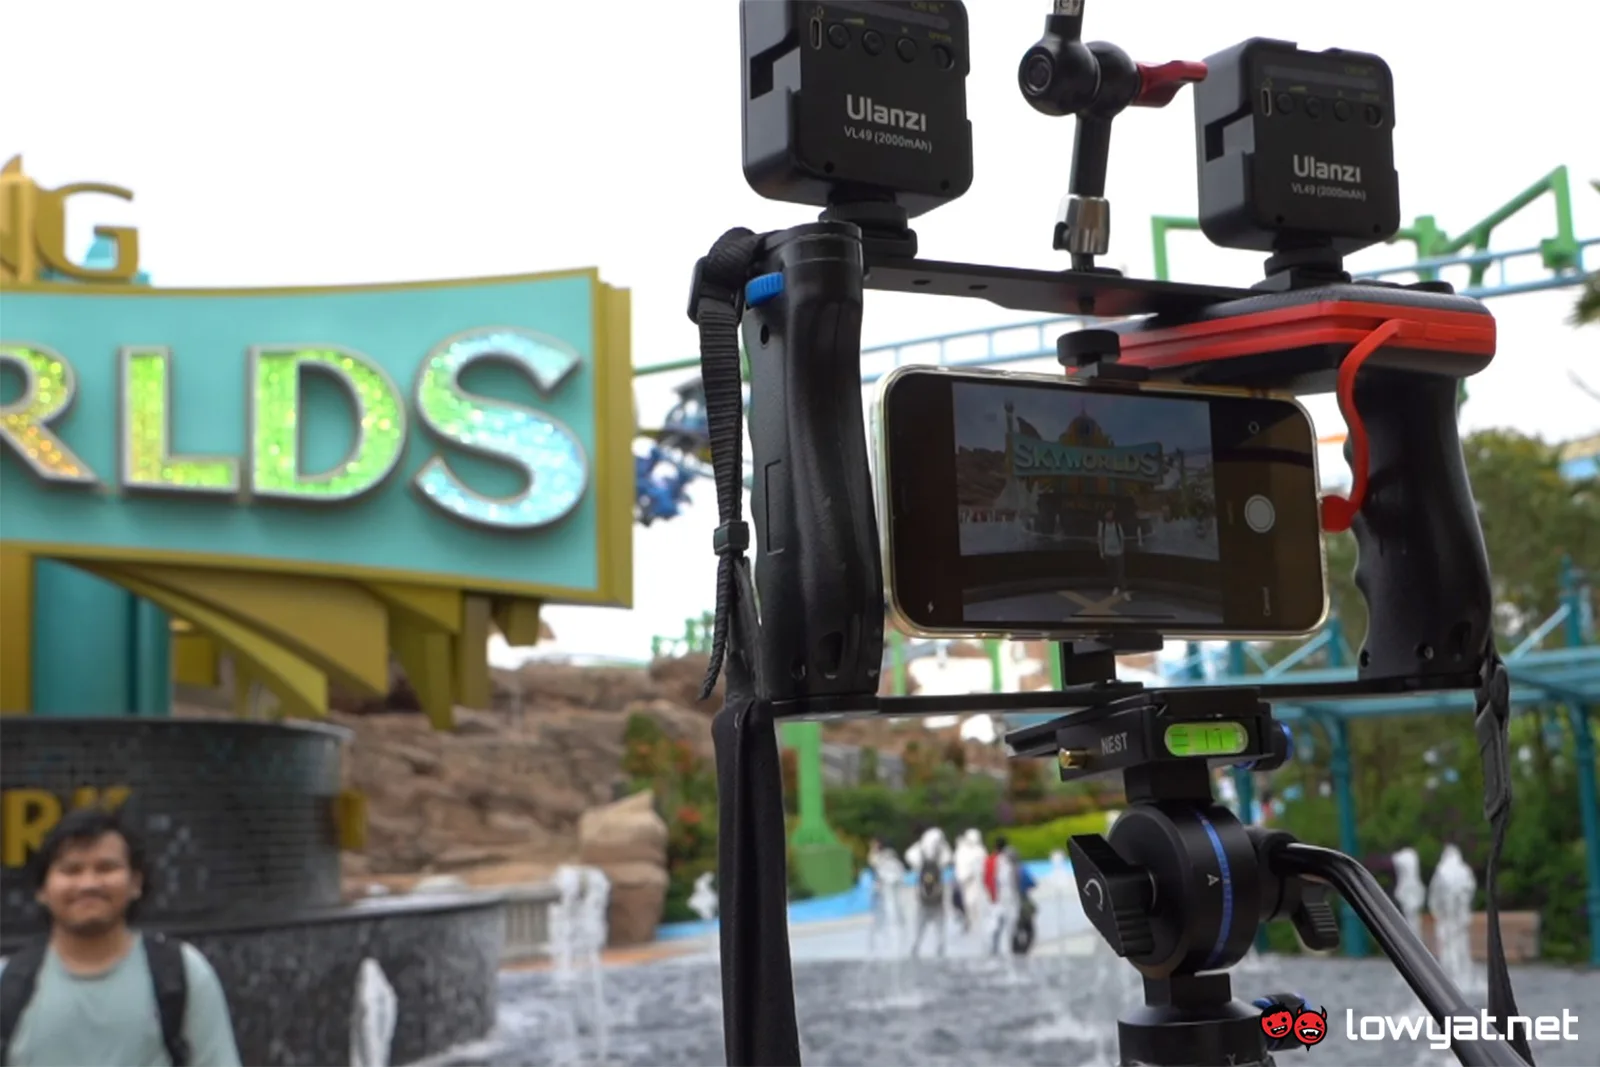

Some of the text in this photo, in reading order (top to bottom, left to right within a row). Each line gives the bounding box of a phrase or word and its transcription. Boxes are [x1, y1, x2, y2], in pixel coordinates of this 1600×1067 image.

[846, 94, 927, 132] Ulanzi
[844, 125, 933, 153] VL49 (2000mAh)
[1293, 154, 1361, 183] Ulanzi
[1291, 182, 1366, 202] VL49 (2000mAh)
[1013, 441, 1159, 477] SKYWORLDS
[1101, 731, 1128, 756] NEST
